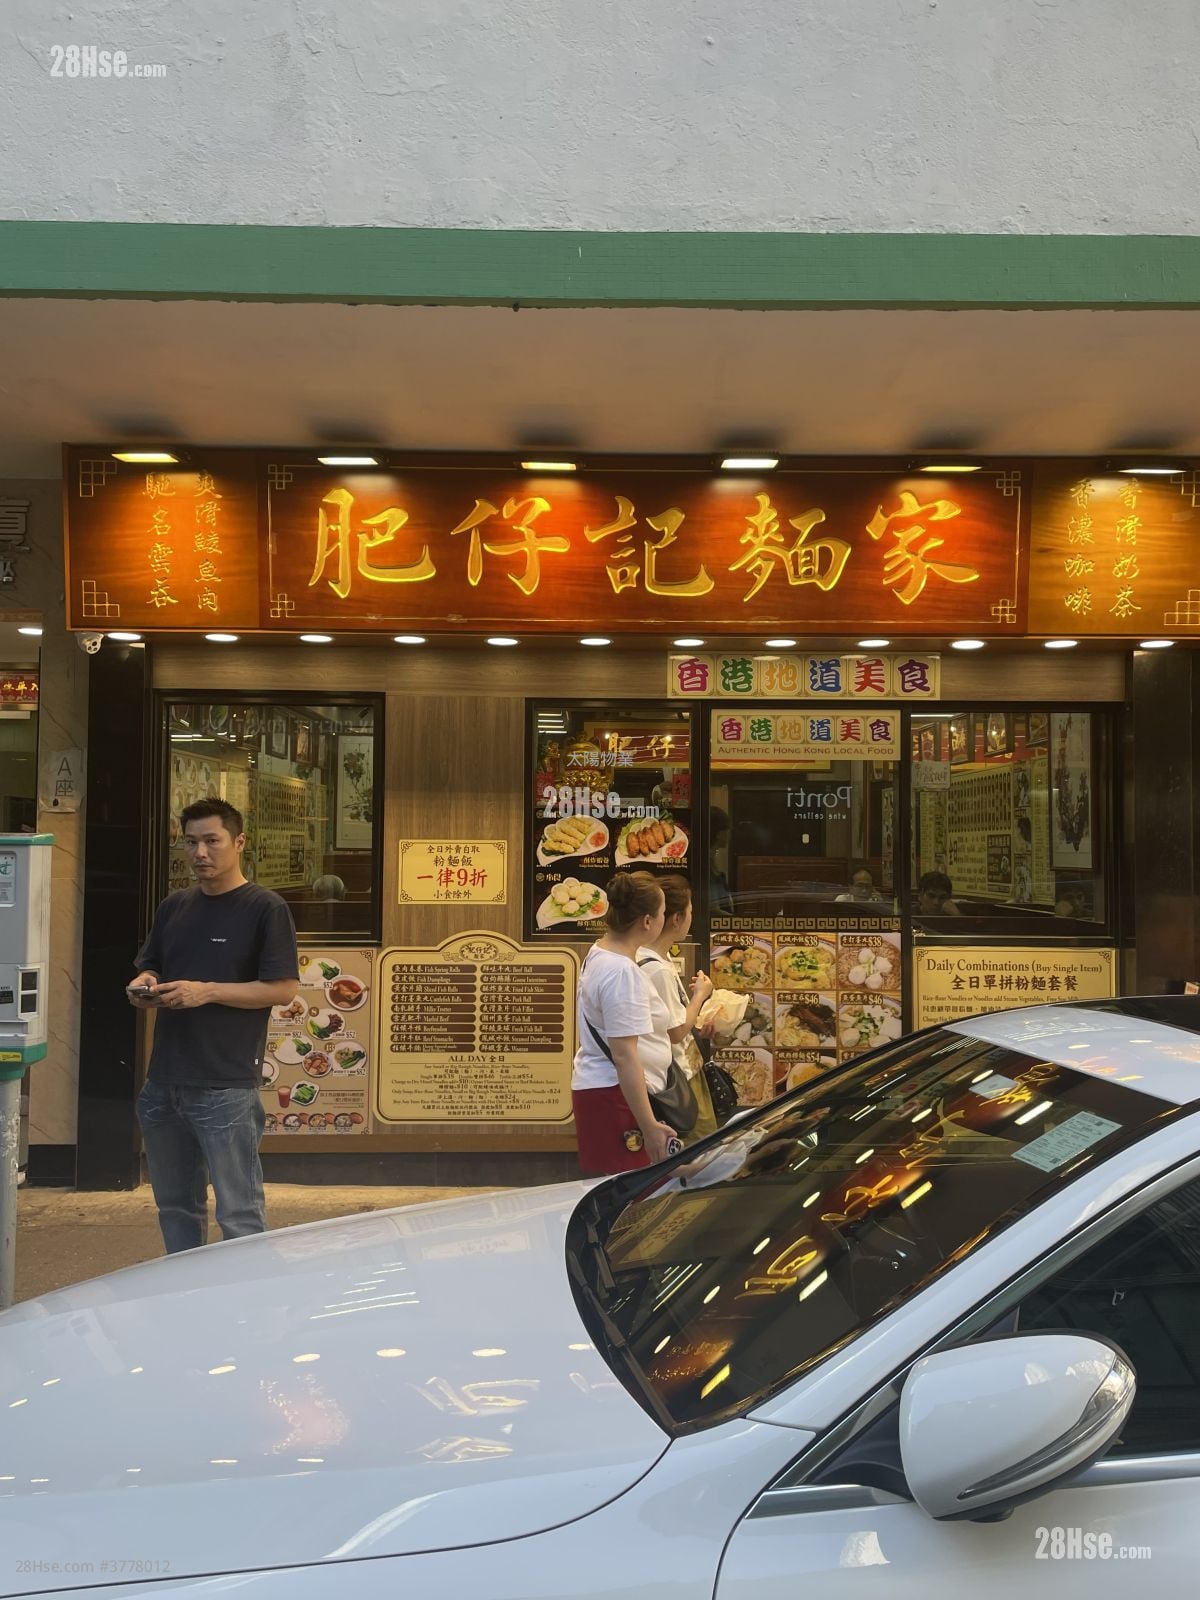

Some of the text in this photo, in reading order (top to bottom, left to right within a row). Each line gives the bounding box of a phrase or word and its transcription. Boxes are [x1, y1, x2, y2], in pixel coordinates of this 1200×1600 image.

[308, 487, 981, 606] 肥仔記麵家
[1063, 477, 1096, 616] 香濃咖啡
[1109, 477, 1143, 618] 香滑奶茶
[677, 657, 932, 693] 香港地道美食
[720, 717, 892, 742] 香港地道美食
[427, 845, 481, 854] 全日外賣自取
[433, 855, 474, 867] 粉麵飯
[416, 868, 488, 888] 一律9折
[433, 889, 473, 900] 小食除外
[740, 936, 754, 946] $38
[804, 936, 818, 946] $38
[868, 937, 882, 947] $38
[927, 959, 1103, 974] Daily Combinations (Buy Single Item)
[952, 974, 1079, 991] 全日單拼粉麵套餐
[804, 994, 819, 1004] $46
[868, 994, 883, 1005] $46
[489, 1055, 505, 1063] 全日
[740, 1052, 754, 1062] $46
[806, 1053, 820, 1063] $54
